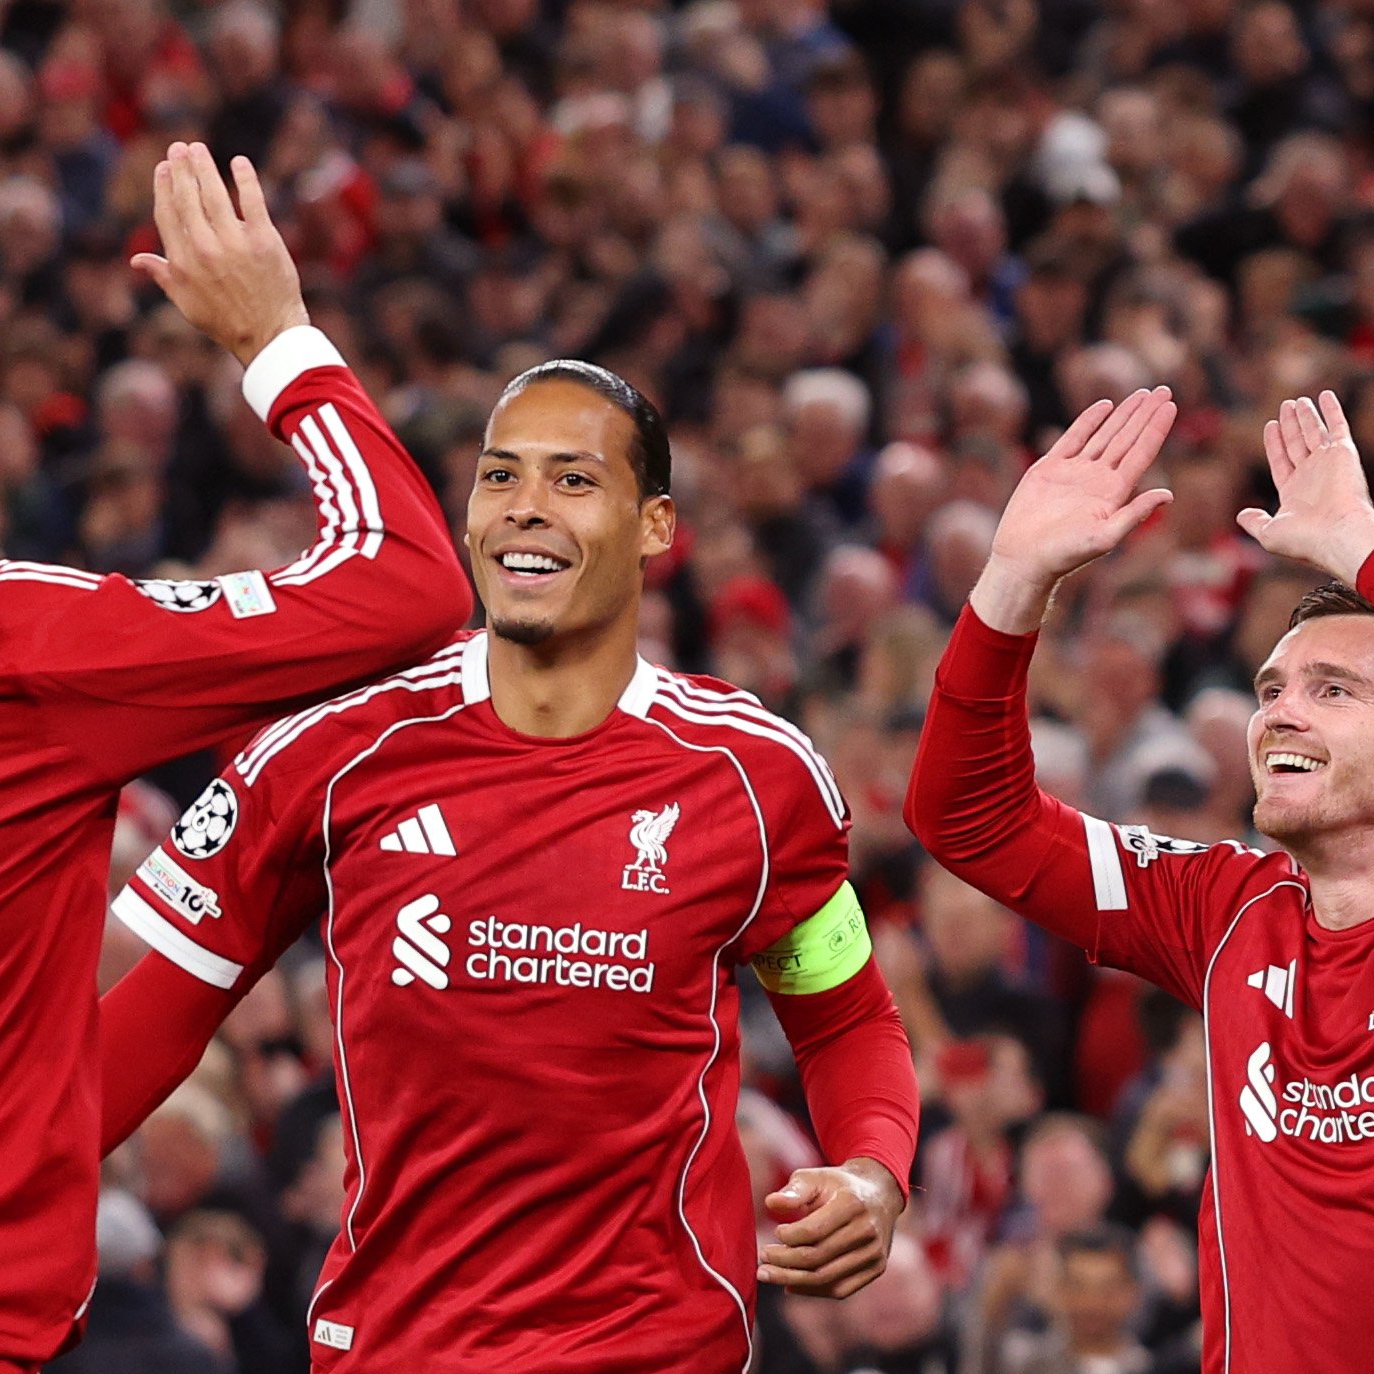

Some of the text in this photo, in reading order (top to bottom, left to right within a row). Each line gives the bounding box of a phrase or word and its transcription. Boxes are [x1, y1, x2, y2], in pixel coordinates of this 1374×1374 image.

[621, 870, 670, 894] L.F.C.
[467, 915, 649, 961] standard
[465, 949, 655, 994] chartered
